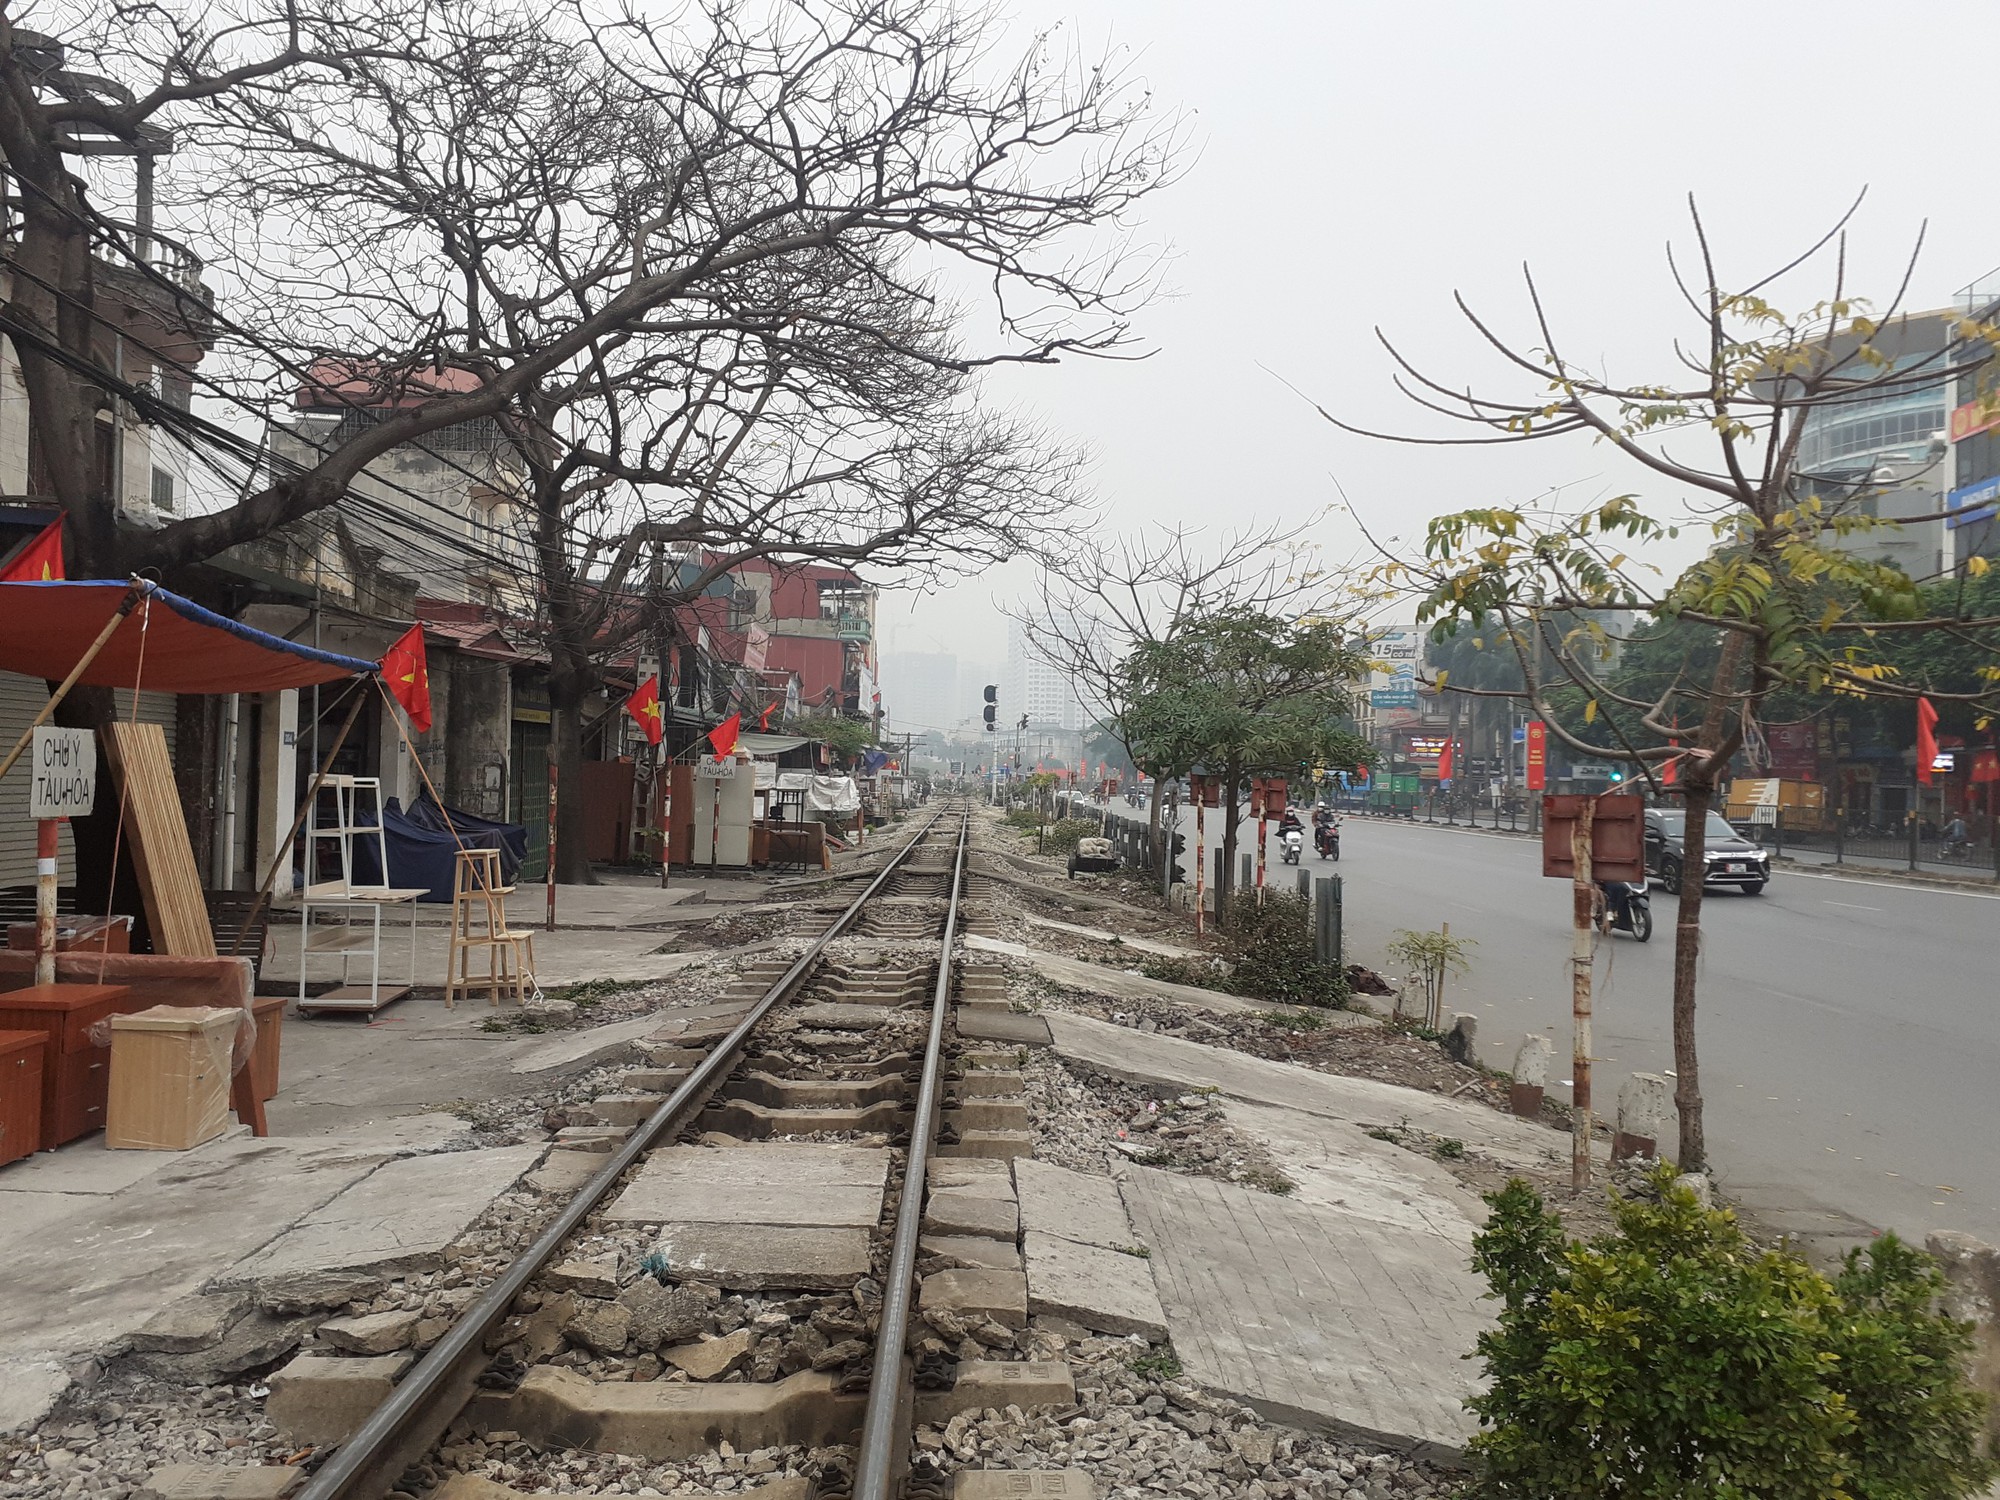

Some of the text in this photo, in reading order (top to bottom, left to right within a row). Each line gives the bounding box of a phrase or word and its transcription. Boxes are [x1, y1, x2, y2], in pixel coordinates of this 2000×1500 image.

[1376, 644, 1392, 655] 15
[44, 734, 80, 767] CHÚ Ý
[707, 757, 721, 766] CH
[65, 769, 89, 805] HỎA
